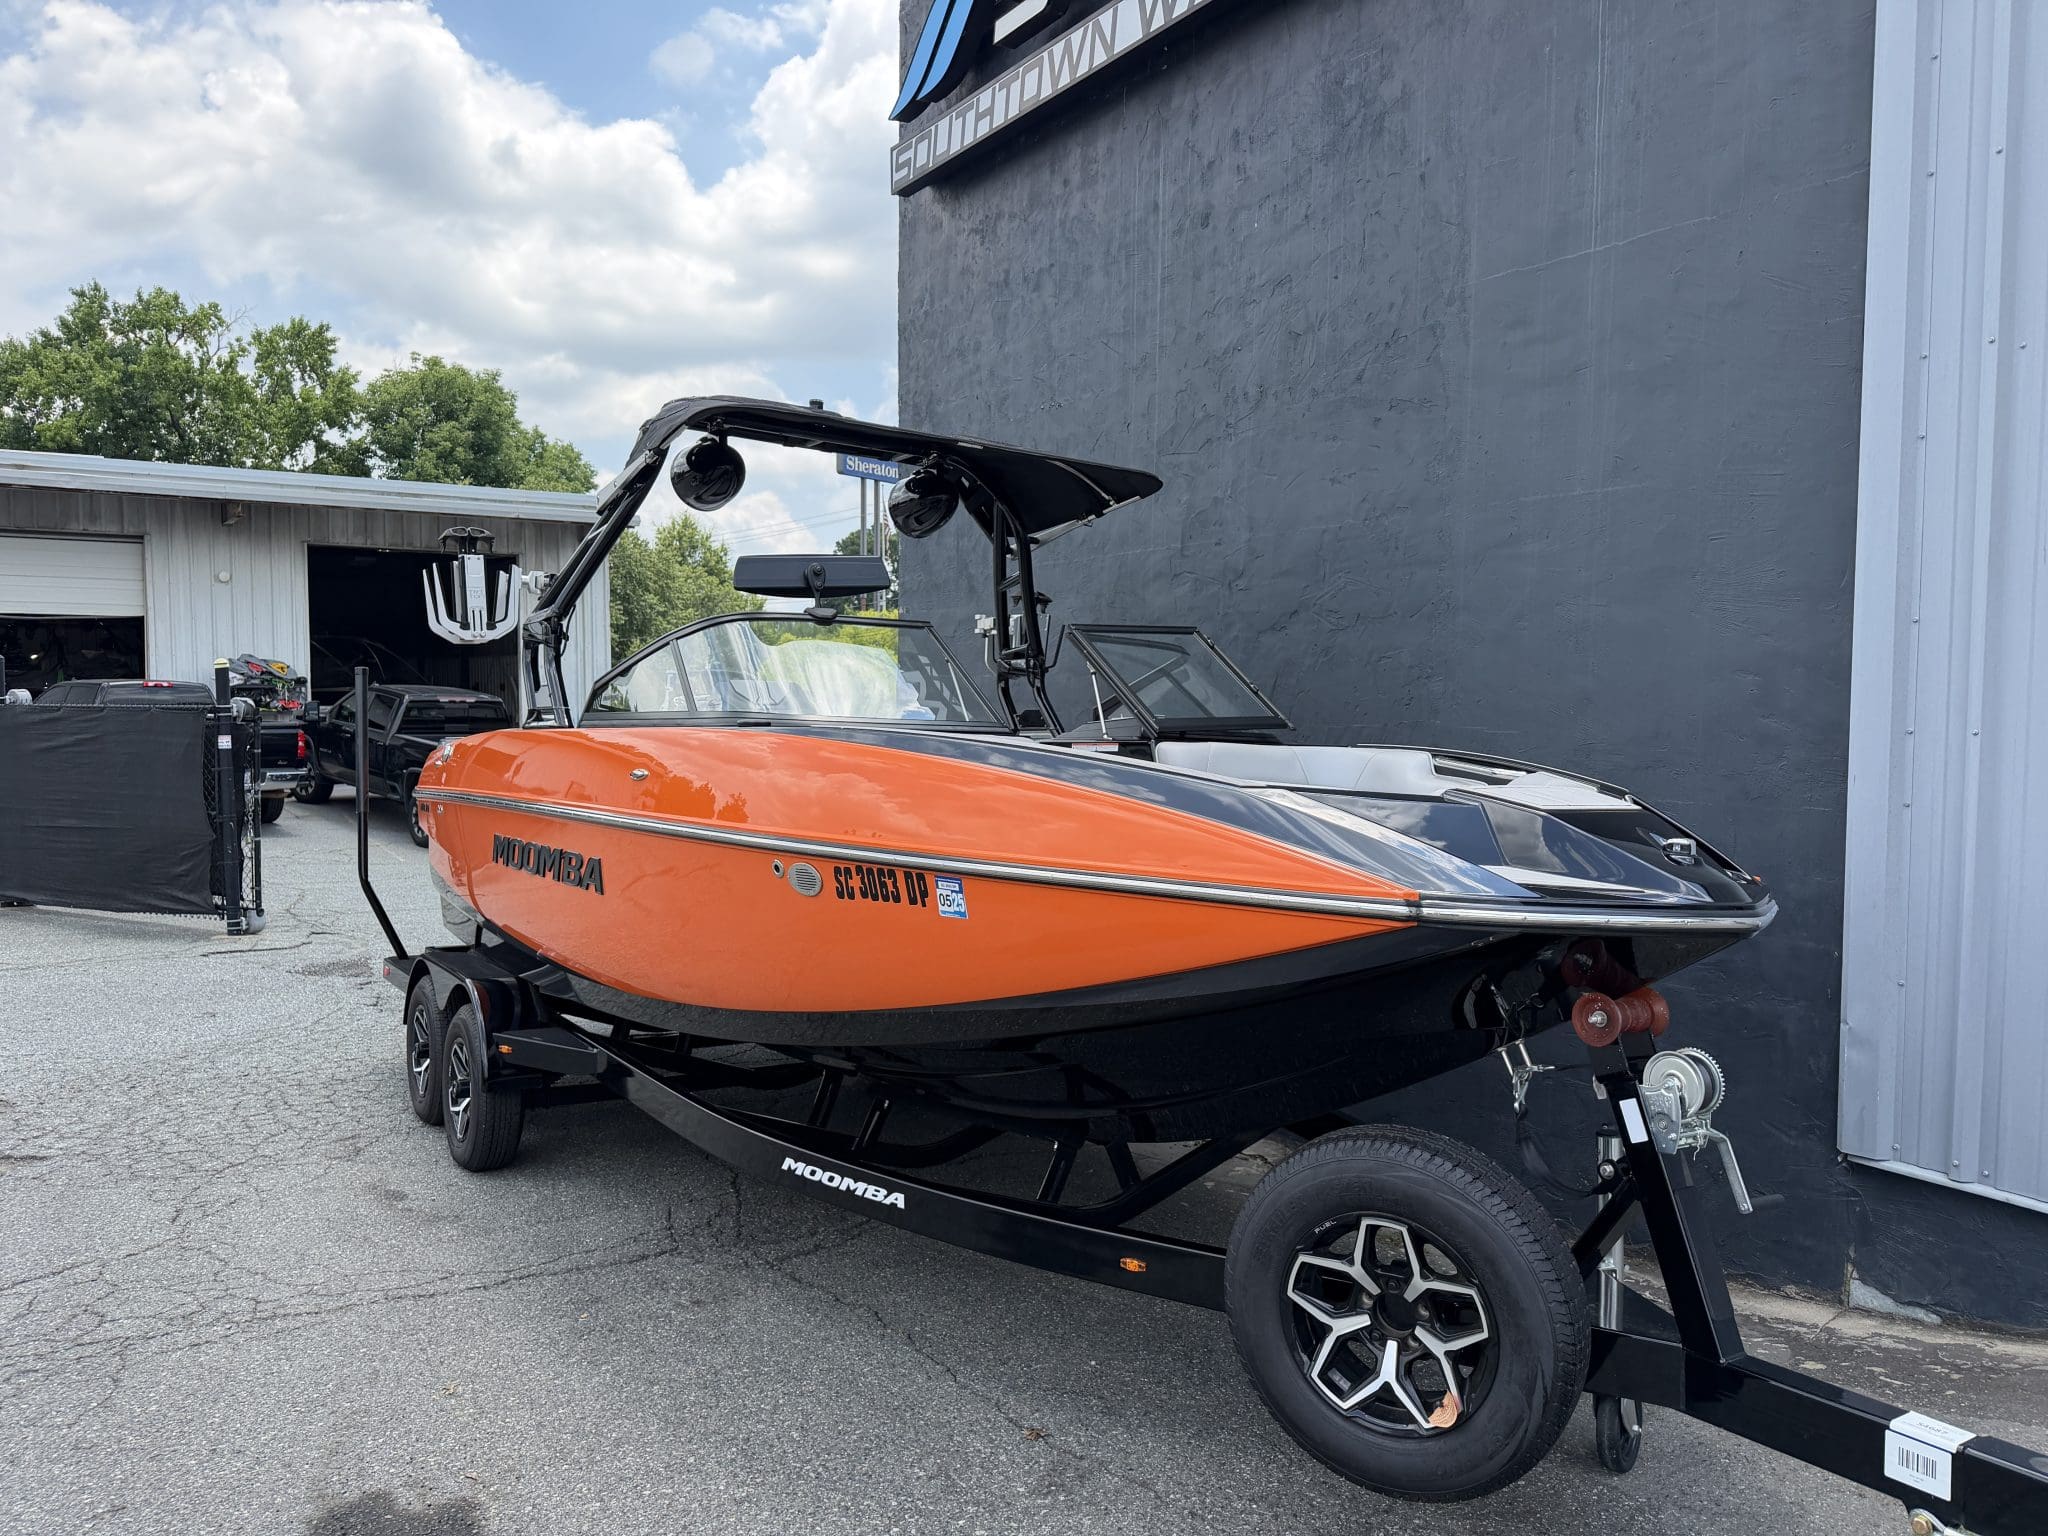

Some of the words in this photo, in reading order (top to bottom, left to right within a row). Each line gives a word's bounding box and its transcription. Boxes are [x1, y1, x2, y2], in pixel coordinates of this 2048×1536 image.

[894, 5, 1118, 183] SOUTHTOWN
[846, 455, 899, 478] Sheraton
[492, 833, 604, 895] MOOMBA
[834, 866, 855, 900] SC
[855, 865, 901, 903] 3063
[904, 871, 929, 907] DP
[781, 1157, 905, 1209] MOOMBA
